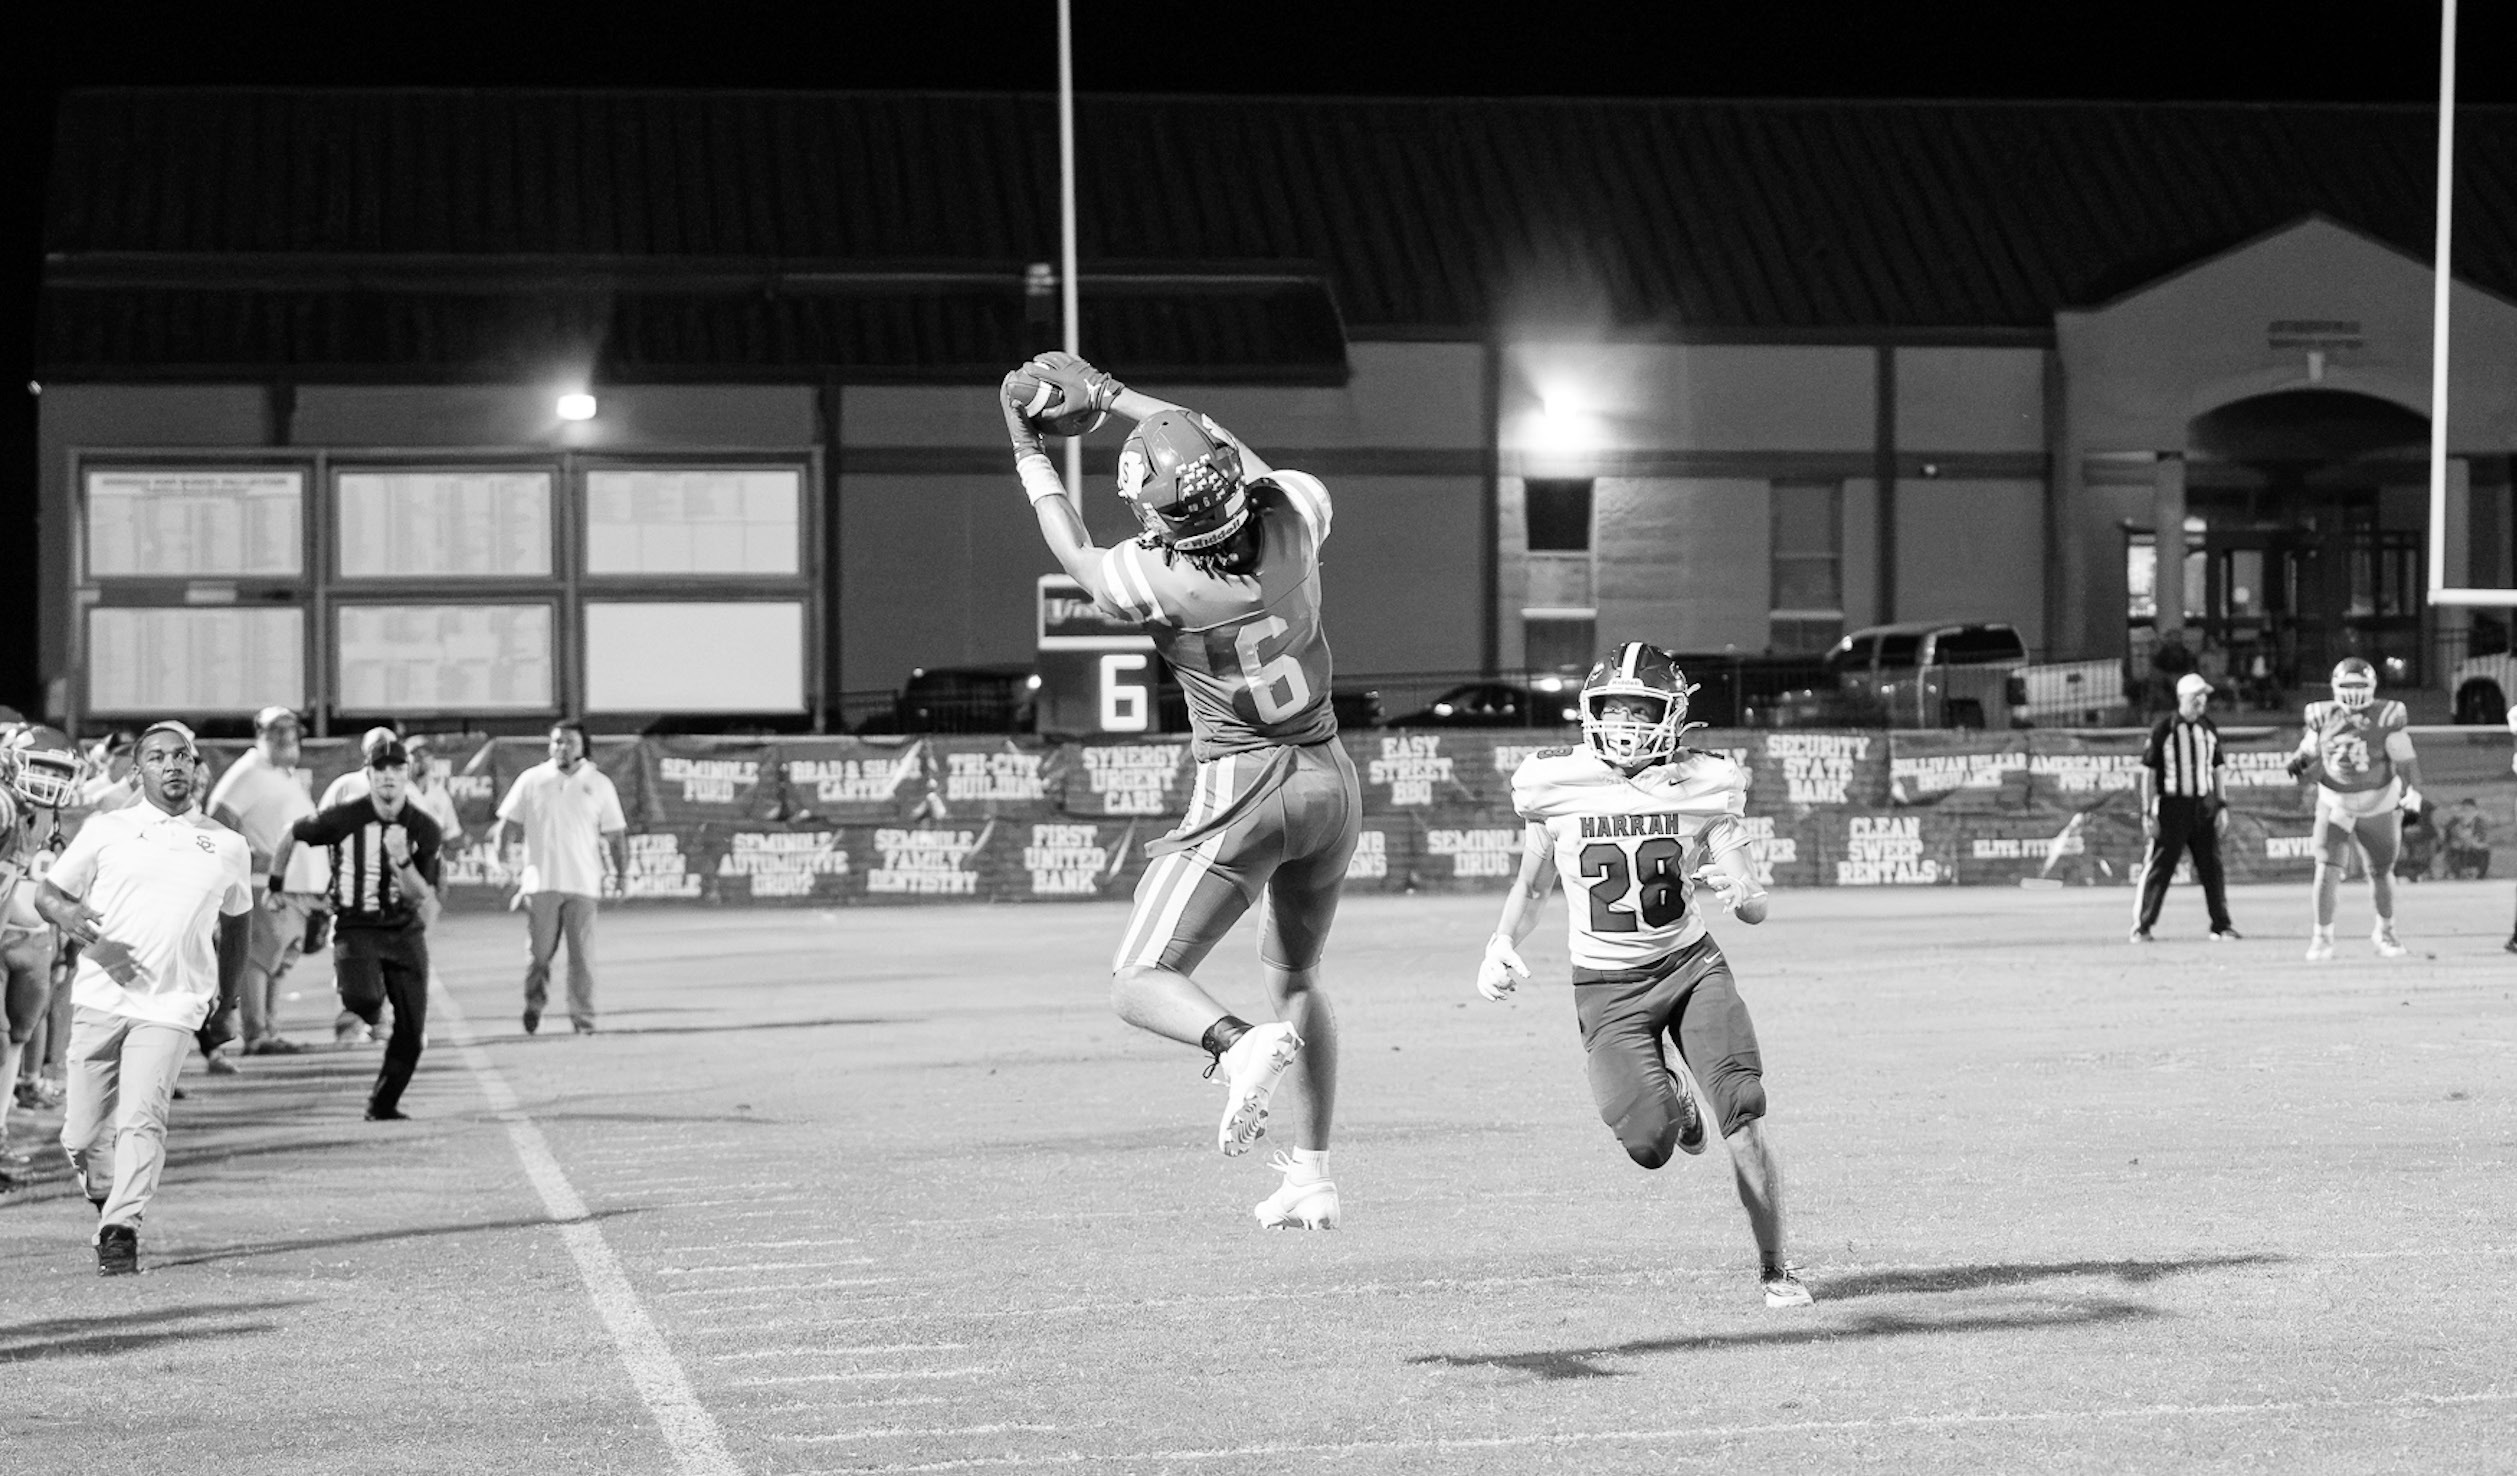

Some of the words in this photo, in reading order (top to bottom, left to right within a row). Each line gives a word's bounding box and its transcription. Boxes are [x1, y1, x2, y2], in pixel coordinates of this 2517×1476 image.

[1234, 614, 1312, 725] 6
[1100, 654, 1149, 732] 6
[1082, 745, 1182, 770] SYNERGY
[1381, 736, 1440, 759] EASY
[1766, 734, 1871, 760] SECURITY
[660, 757, 759, 784] SEMINOLE
[1368, 757, 1454, 784] STREET
[1783, 757, 1854, 780] STATE
[1889, 756, 1968, 777] SULLIVAN
[2029, 755, 2111, 774] AMERICAN
[1090, 767, 1178, 792] URGENT
[1788, 778, 1848, 803] BANK
[1103, 790, 1164, 814] CARE
[1391, 780, 1432, 805] BBQ
[1033, 824, 1098, 848] FIRST
[1579, 813, 1680, 838] HARRAH
[1850, 816, 1920, 838] CLEAN
[732, 832, 832, 853] SEMINOLE
[874, 829, 974, 851] SEMINOLE
[1847, 838, 1924, 862] SWEEP
[884, 850, 962, 871] FAMILY
[1024, 847, 1106, 871] UNITED
[1453, 852, 1510, 876] DRUG
[867, 868, 978, 893] DENTISTRY
[1032, 869, 1097, 893] BANK
[1579, 837, 1687, 932] 28
[1837, 860, 1938, 885] RENTALS
